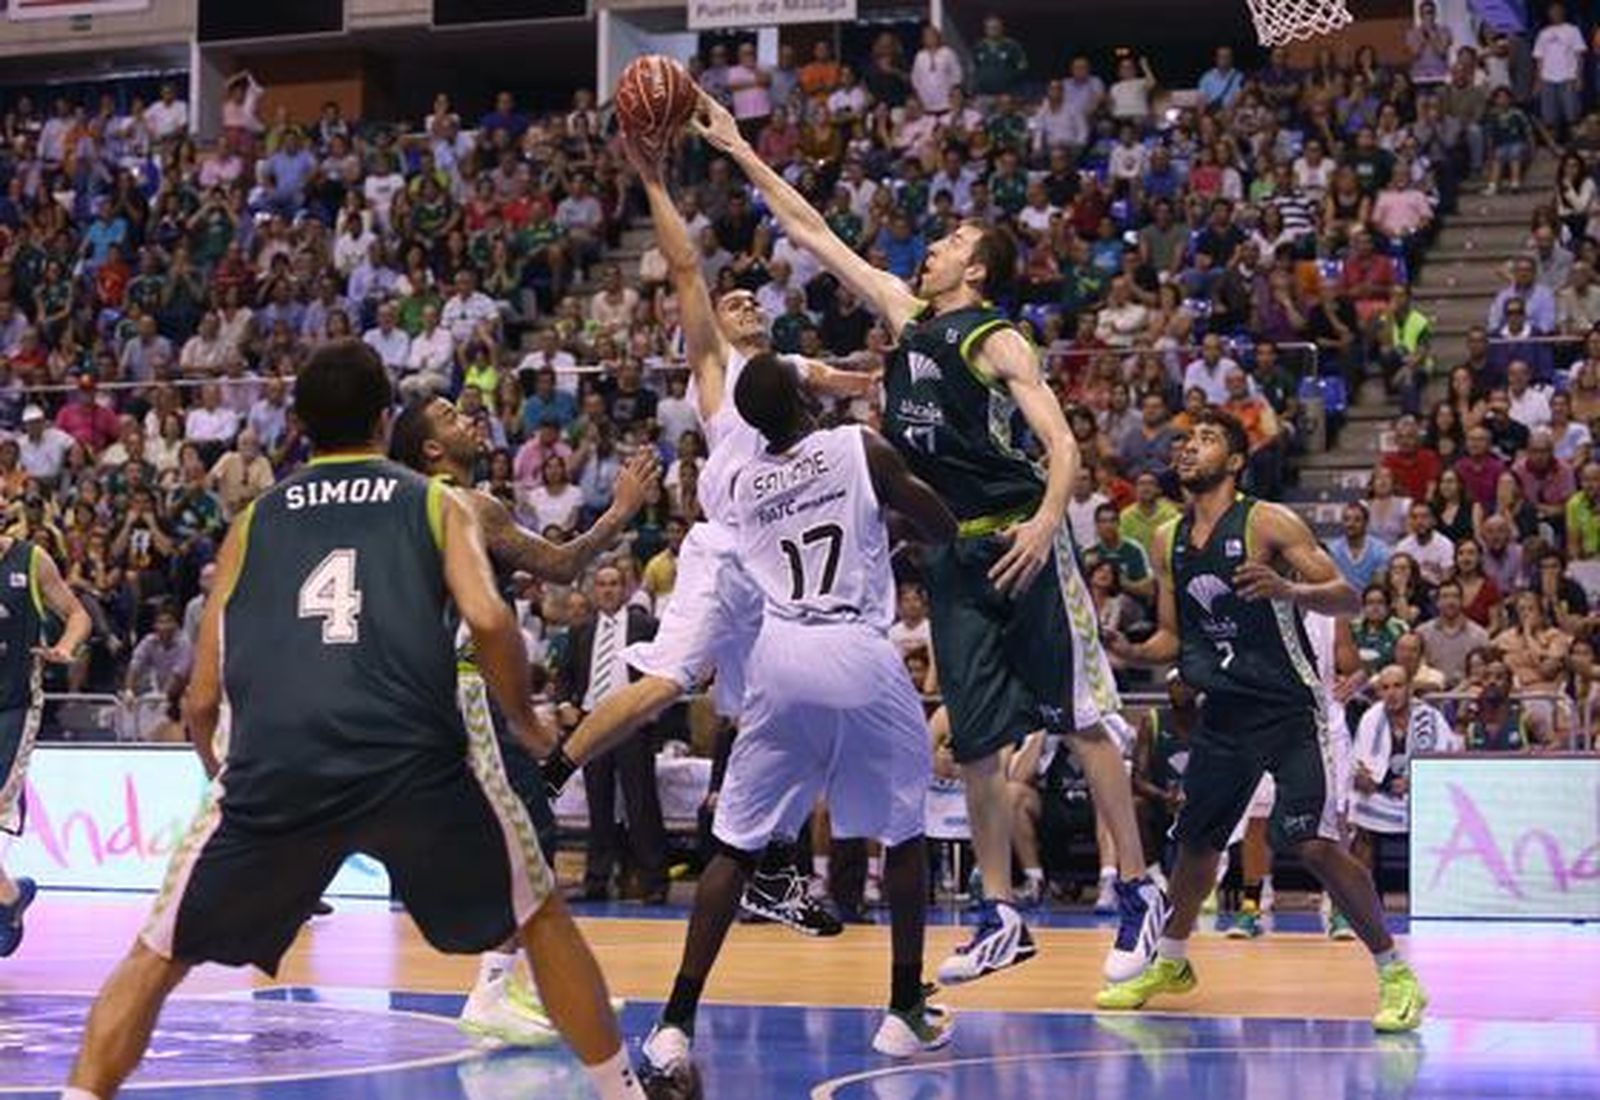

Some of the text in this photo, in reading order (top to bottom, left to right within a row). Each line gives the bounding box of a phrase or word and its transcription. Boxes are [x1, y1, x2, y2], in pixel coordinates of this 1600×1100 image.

[696, 3, 752, 18] Puerto
[756, 1, 776, 14] de
[285, 477, 397, 510] SIMON
[780, 522, 843, 601] 17
[298, 548, 362, 644] 4
[1216, 641, 1235, 669] 7
